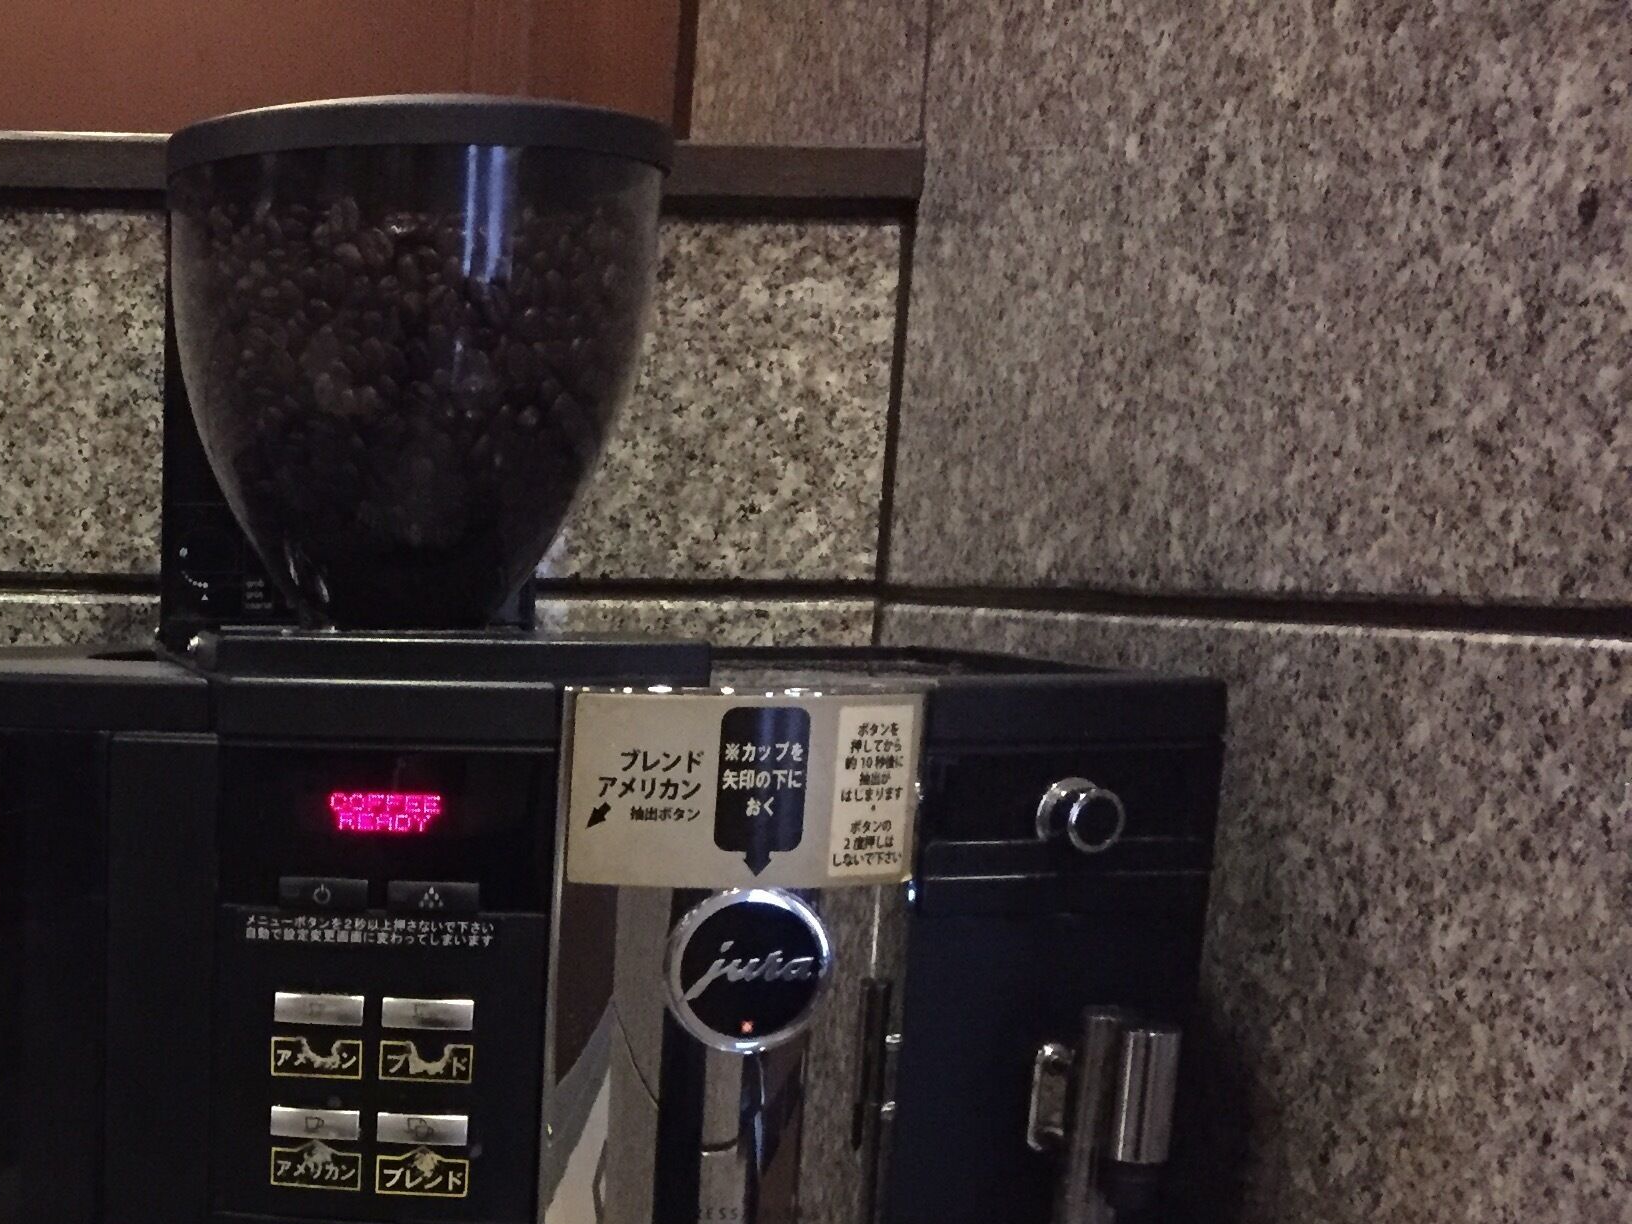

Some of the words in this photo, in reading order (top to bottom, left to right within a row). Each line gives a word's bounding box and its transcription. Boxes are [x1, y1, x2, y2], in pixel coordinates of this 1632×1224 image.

[857, 722, 899, 738] ボタンを
[850, 738, 902, 754] 押してから
[619, 749, 705, 773] ブレンド
[597, 776, 703, 800] アメリカン
[722, 769, 803, 791] 矢印の下に
[329, 792, 442, 815] COFFEE
[629, 806, 701, 822] 抽出ボタン
[745, 796, 776, 817] おく
[338, 812, 432, 833] READY
[849, 820, 893, 835] ボタンの
[832, 851, 903, 867] しないで下さい
[683, 940, 815, 1001] jura
